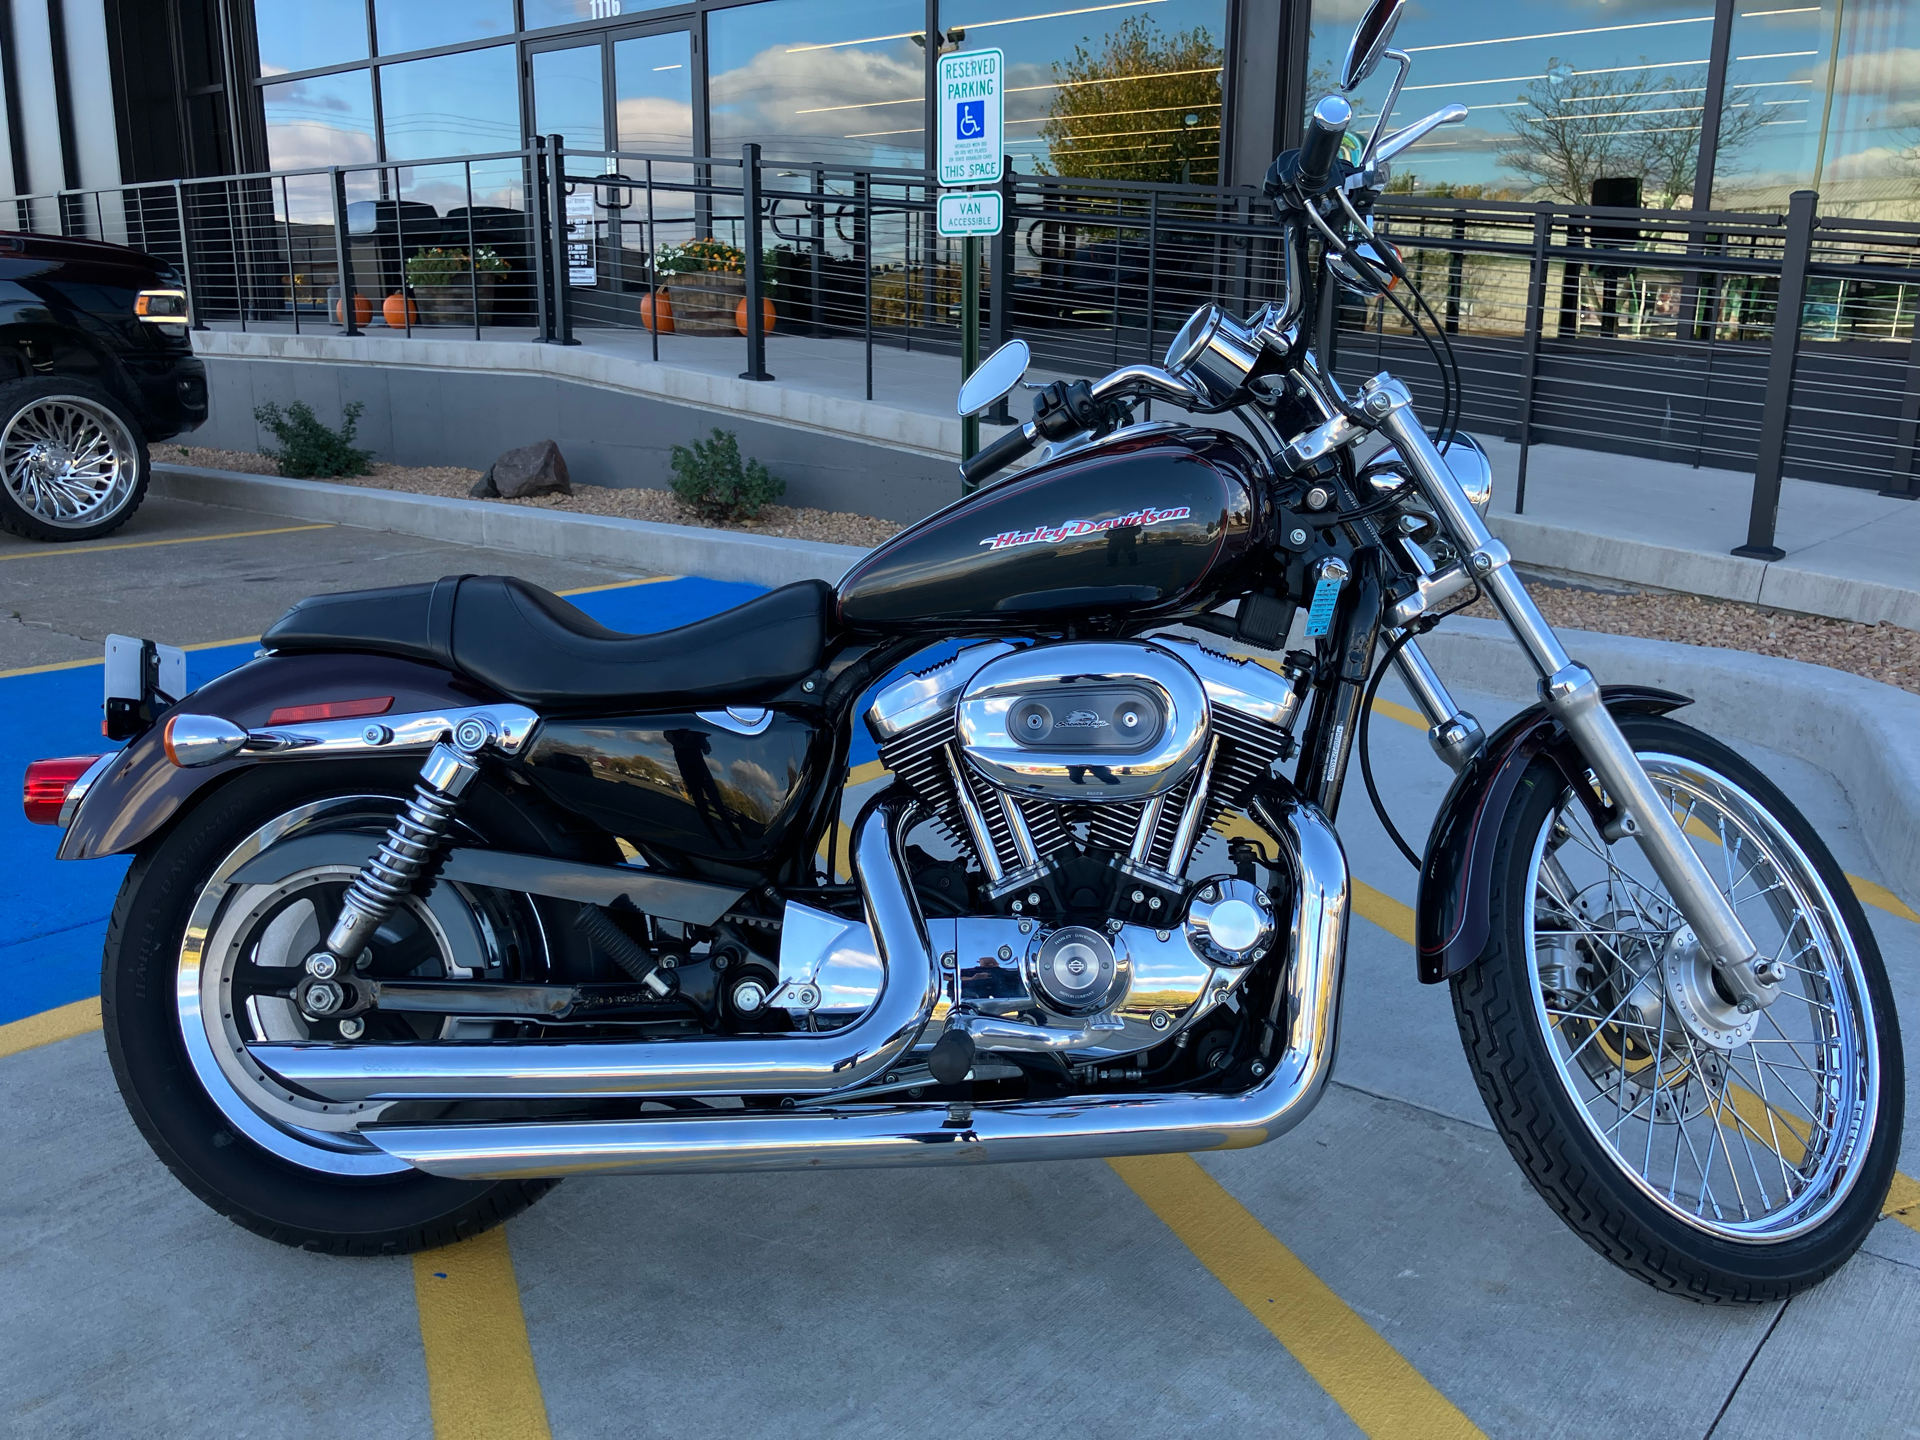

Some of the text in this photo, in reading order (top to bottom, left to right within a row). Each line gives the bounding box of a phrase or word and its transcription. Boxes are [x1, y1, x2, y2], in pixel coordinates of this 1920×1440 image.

[590, 0, 621, 20] 1116
[946, 58, 995, 80] RESERVED
[948, 79, 993, 100] PARKING
[945, 162, 996, 178] THIS SPACE
[960, 202, 981, 215] VAN
[949, 216, 991, 227] ACCESSIBLE
[979, 506, 1191, 551] Harley-Davidson
